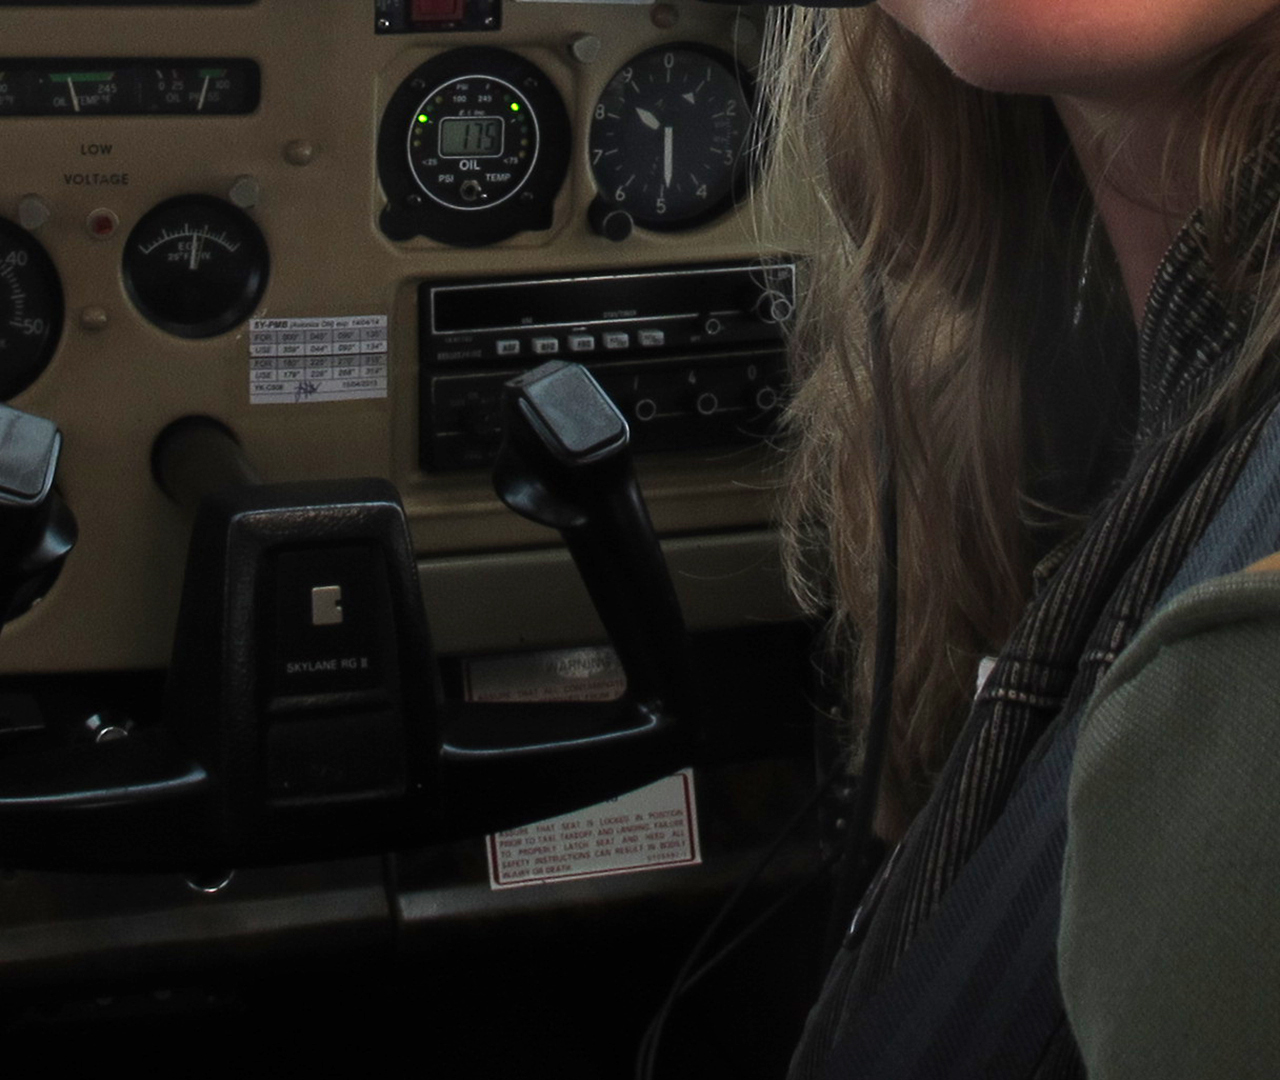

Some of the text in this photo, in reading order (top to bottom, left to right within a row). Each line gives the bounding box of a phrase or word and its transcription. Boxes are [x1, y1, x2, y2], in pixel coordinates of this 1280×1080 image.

[664, 52, 674, 69] 0
[623, 66, 634, 83] 9
[97, 82, 117, 95] 245
[157, 81, 166, 92] 0
[452, 95, 467, 104] 100
[726, 99, 737, 117] 2
[595, 103, 606, 120] 8
[463, 122, 496, 151] 175
[80, 143, 113, 156] LOW
[593, 149, 604, 166] 7
[459, 160, 481, 172] OIL
[723, 150, 734, 167] 3
[63, 172, 129, 186] VOLTAGE
[438, 174, 455, 184] PSI
[484, 173, 512, 183] TEMP
[615, 184, 626, 201] 6
[696, 184, 708, 200] 4
[656, 198, 667, 214] 5
[5, 250, 28, 267] 40
[23, 319, 44, 336] 50
[286, 659, 338, 674] SKYLANE
[341, 657, 358, 669] RG
[536, 823, 555, 832] THAT
[562, 820, 581, 830] SEAT
[600, 816, 630, 826] LOCKED
[500, 839, 523, 848] PRIOR
[525, 837, 536, 846] TO
[598, 827, 614, 837] AND
[501, 850, 512, 859] TO
[518, 845, 557, 857] PROPERLY
[563, 841, 590, 852] LATCH
[596, 838, 614, 848] SEAT
[622, 835, 639, 844] AND
[672, 829, 685, 838] ALL
[502, 858, 531, 869] SAFETY
[535, 851, 591, 866] INSTRUCTIONS
[594, 849, 612, 858] CAN
[615, 843, 643, 855] RESULT
